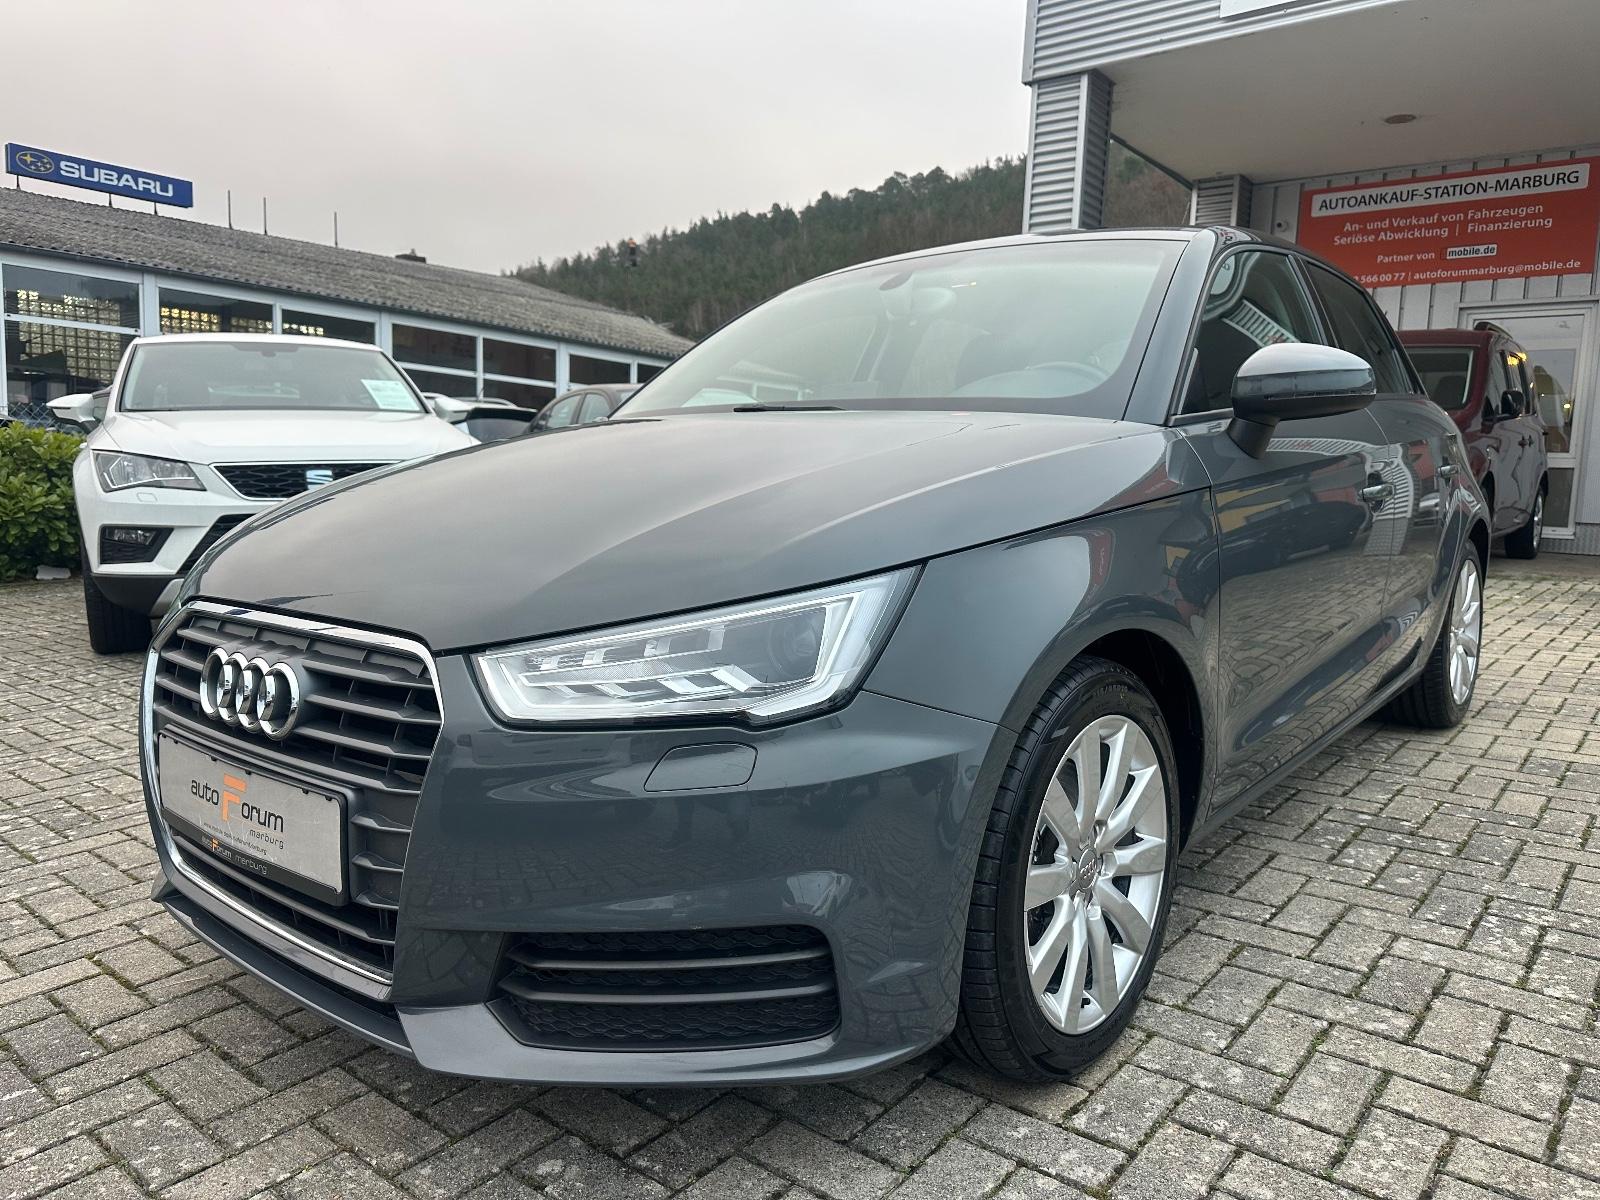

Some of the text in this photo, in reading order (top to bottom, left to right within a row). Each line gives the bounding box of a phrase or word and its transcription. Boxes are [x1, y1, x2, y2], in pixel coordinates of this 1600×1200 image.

[60, 160, 173, 197] SUBARU
[1319, 170, 1580, 211] AUTOANKAUF-STATION-MARBURG
[1344, 205, 1543, 232] An- und Verkauf von Fahrzeugen
[1333, 218, 1553, 245] Seriöse Abwicklung Finanzierung
[1377, 245, 1496, 263] Partner von mobile.de
[1413, 259, 1581, 280] autoforummarburg@mobile.de
[250, 829, 284, 850] marburg
[235, 855, 267, 875] marburg
